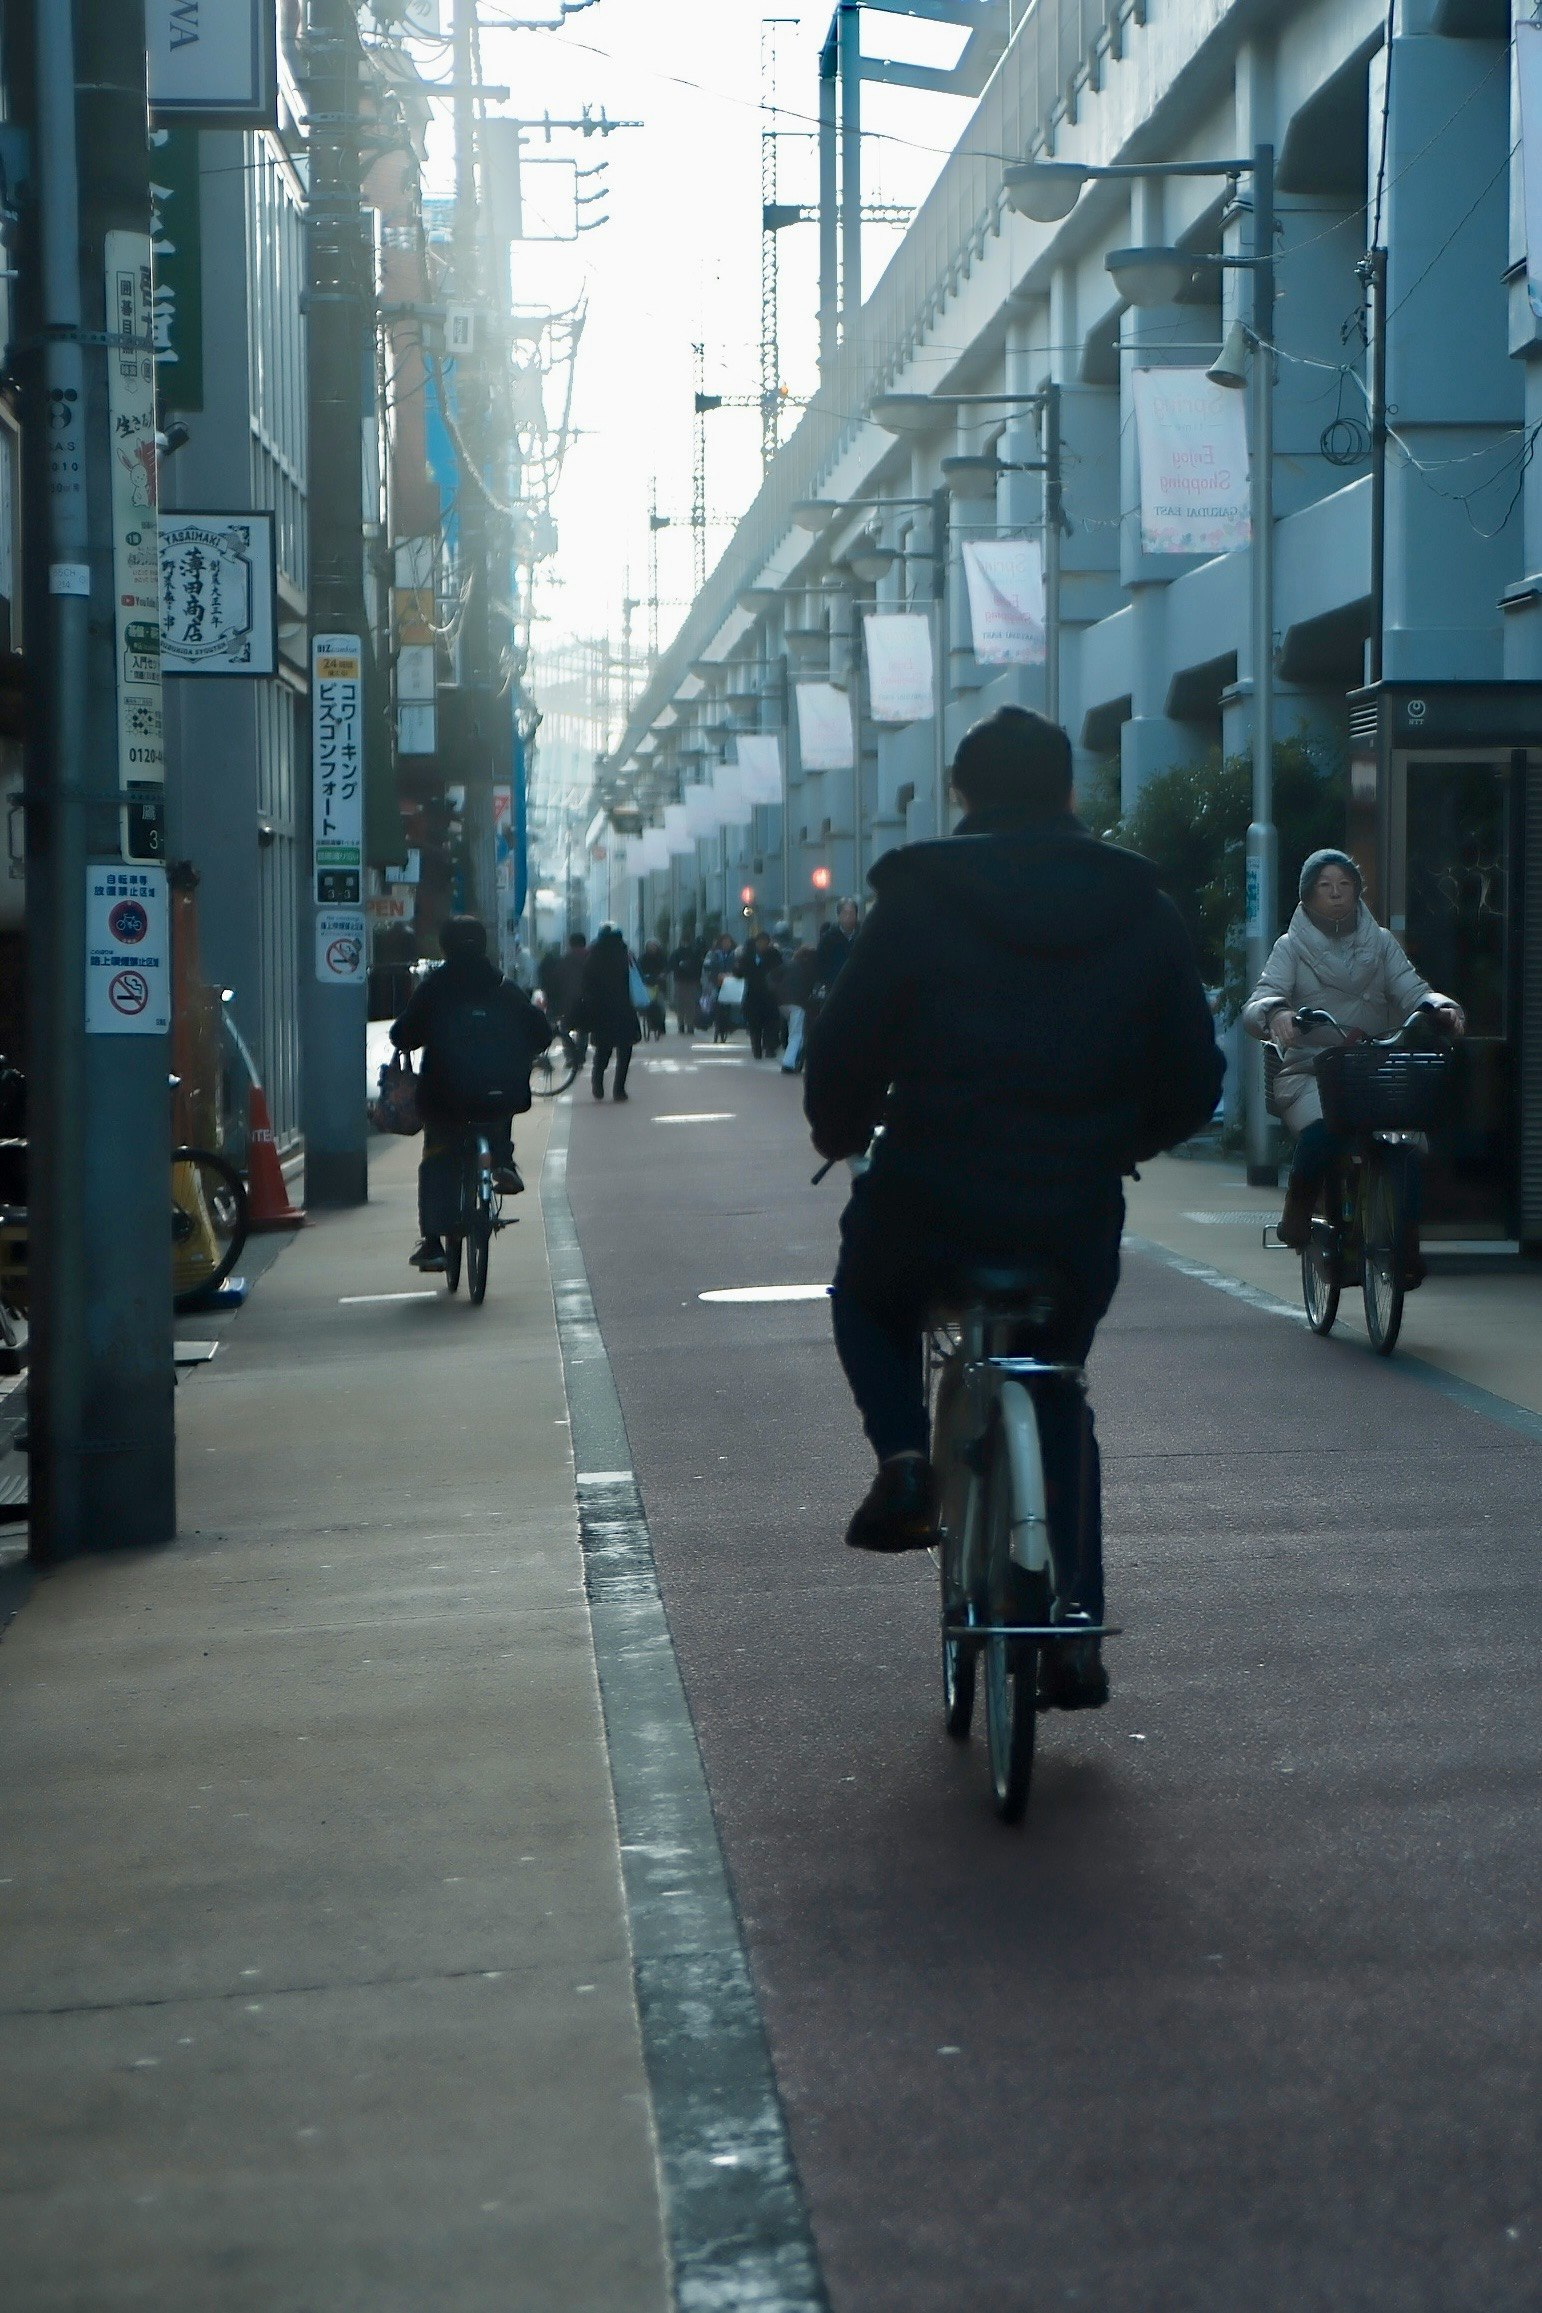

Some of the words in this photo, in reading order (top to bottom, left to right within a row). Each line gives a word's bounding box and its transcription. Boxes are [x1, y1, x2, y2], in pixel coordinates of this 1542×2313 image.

[163, 530, 221, 547] YASAIMAKI
[180, 546, 206, 642] 薄田商店
[319, 683, 337, 836] ビズコンフォート
[341, 684, 358, 801] コワーキング
[106, 875, 148, 886] 自転車等
